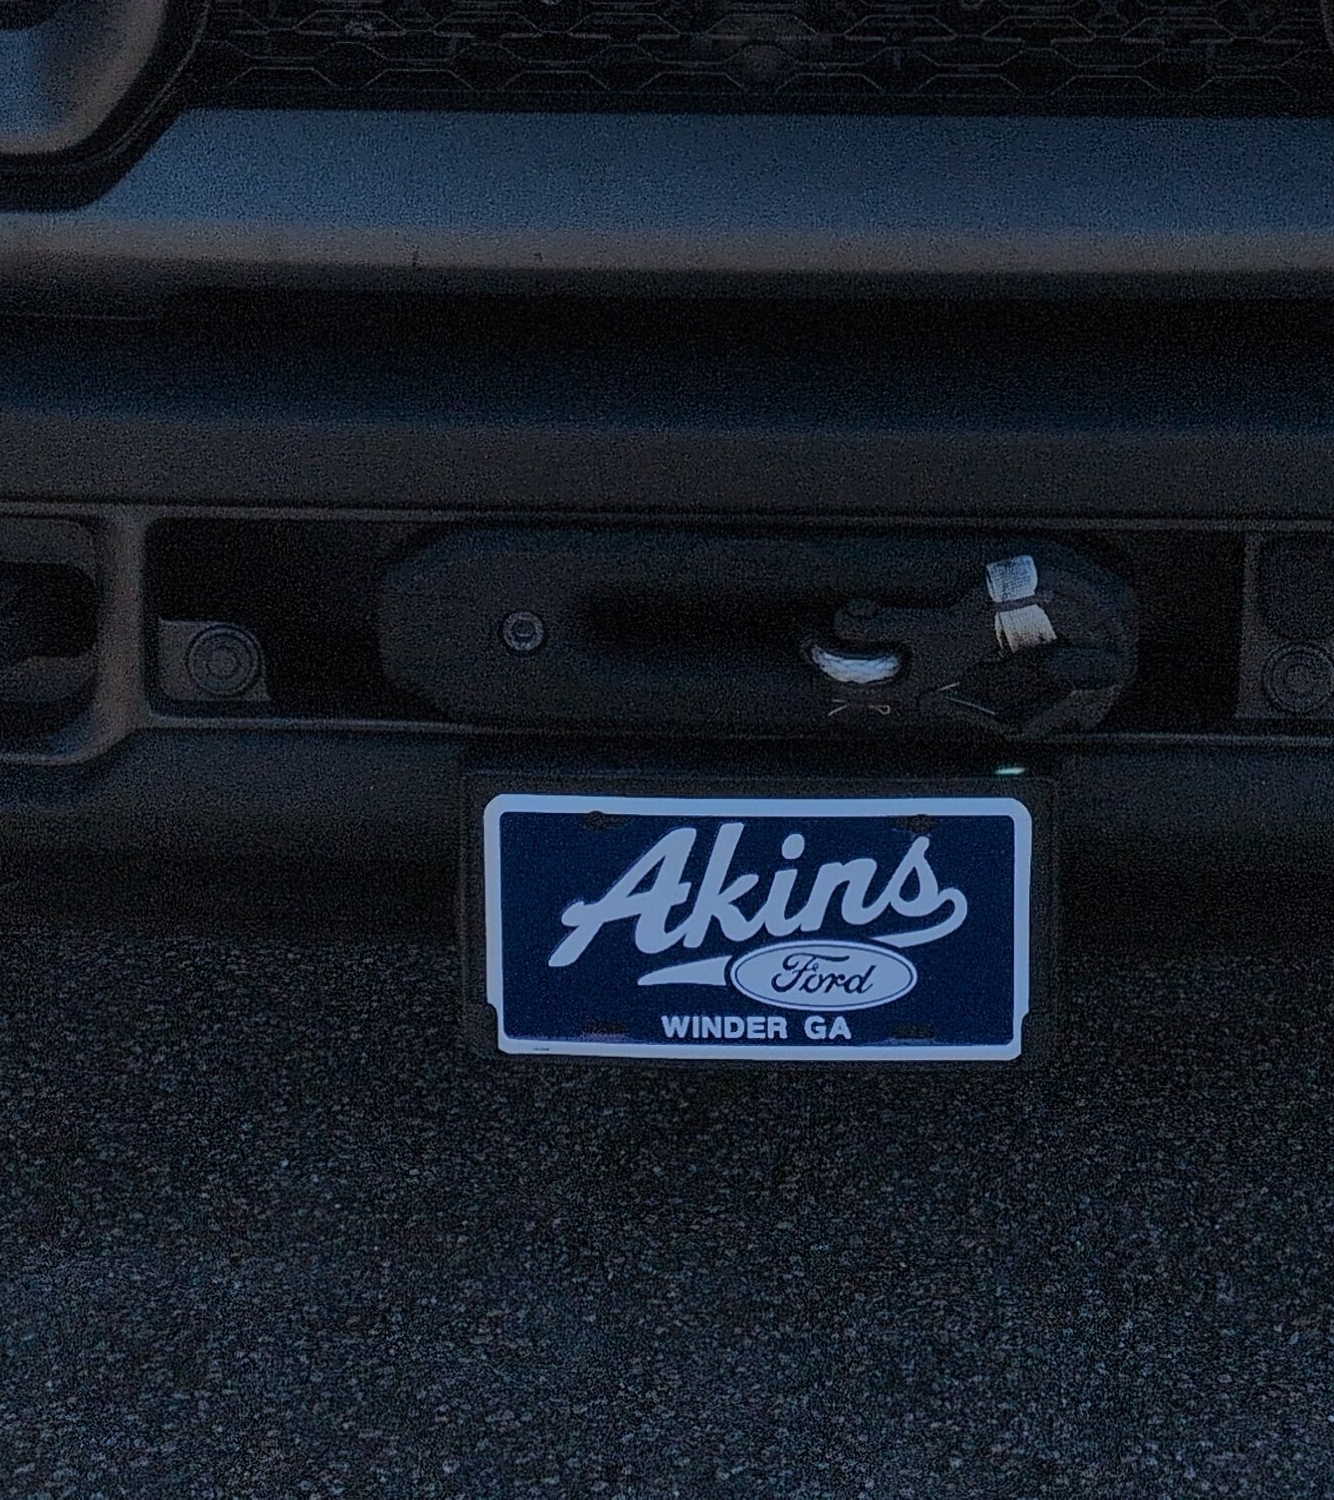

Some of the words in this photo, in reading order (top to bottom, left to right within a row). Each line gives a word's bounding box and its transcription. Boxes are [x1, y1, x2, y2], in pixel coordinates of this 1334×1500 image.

[548, 821, 967, 967] Akins
[770, 953, 875, 995] Ford
[661, 1015, 788, 1039] WINDER
[804, 1015, 851, 1040] GA
